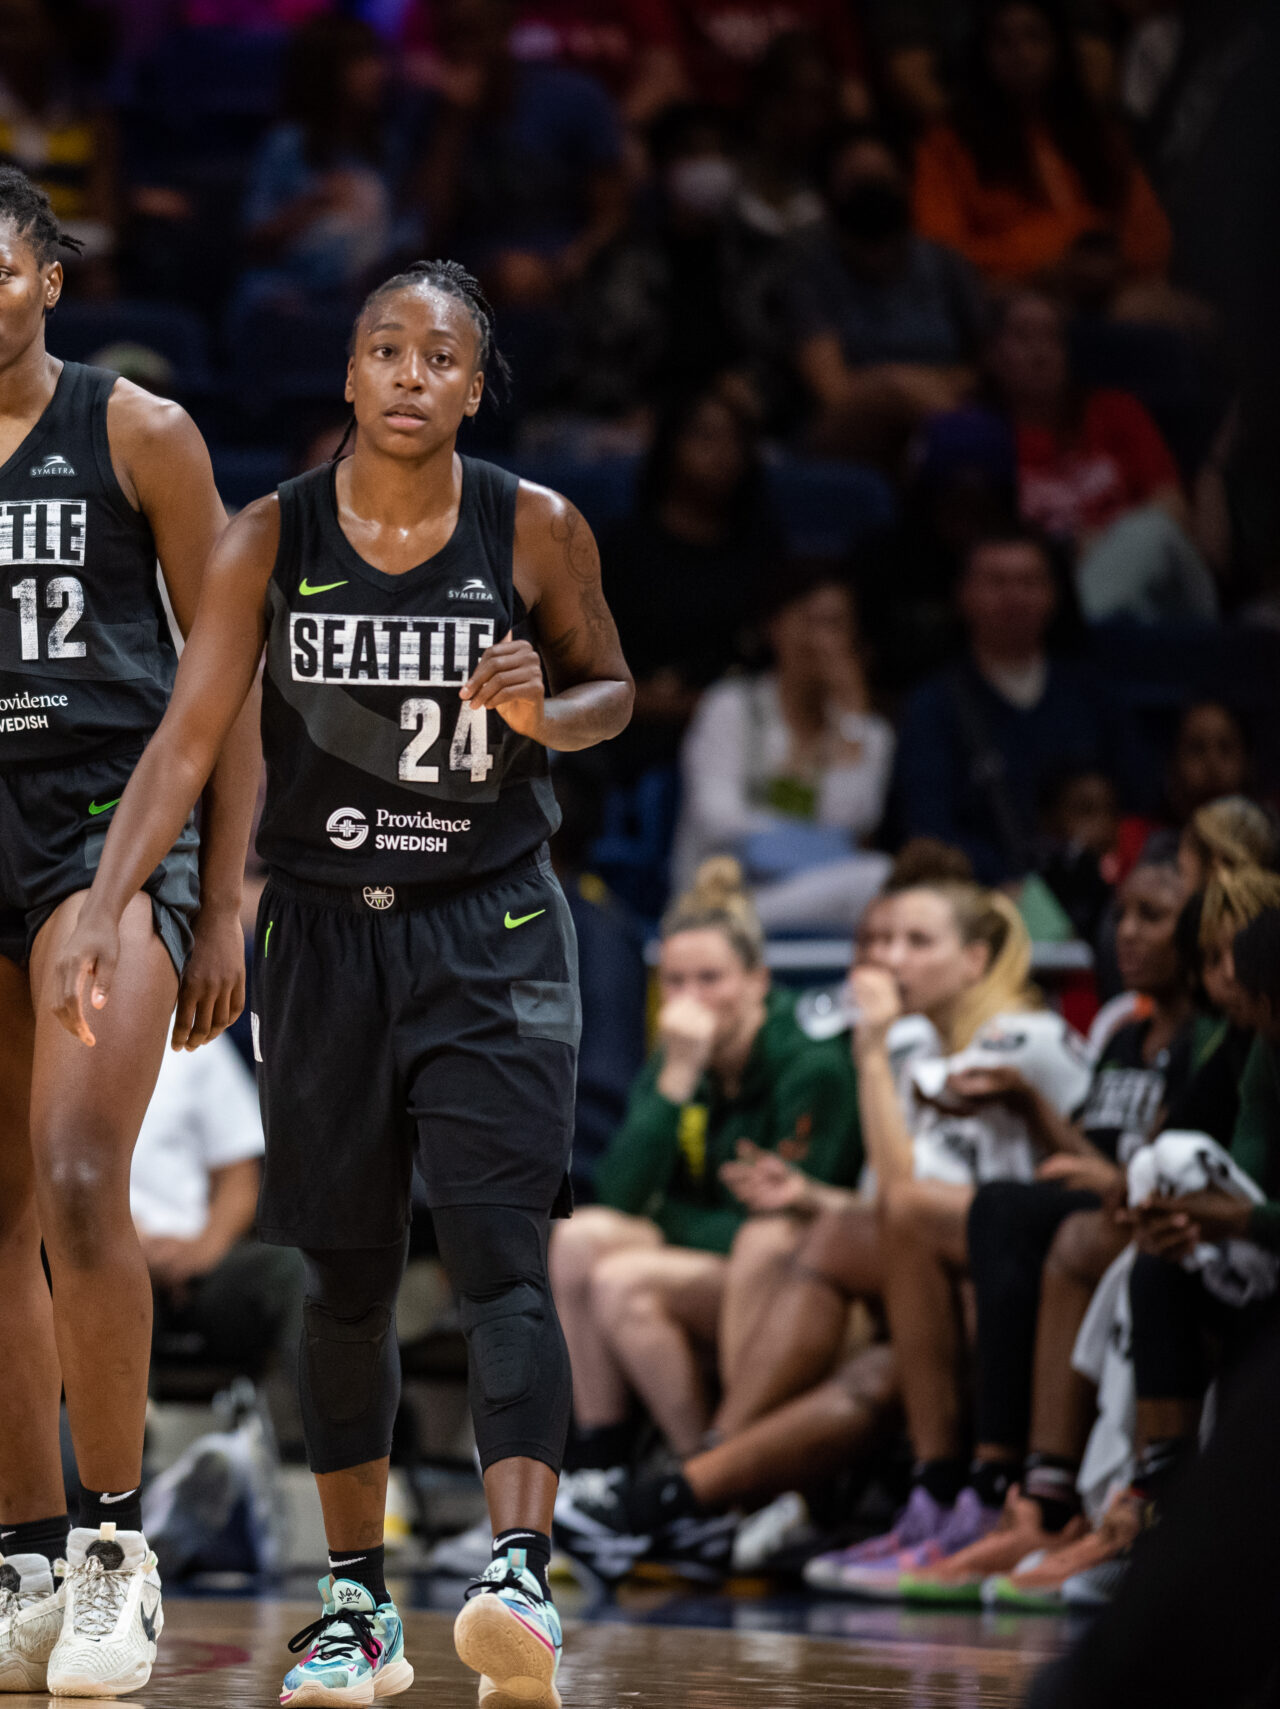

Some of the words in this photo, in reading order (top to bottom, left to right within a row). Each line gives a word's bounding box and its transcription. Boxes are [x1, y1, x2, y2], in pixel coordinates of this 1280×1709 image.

[31, 466, 75, 476] SYMETRA
[448, 589, 493, 601] SYMETRA
[11, 576, 87, 662] 12
[398, 698, 494, 783] 24
[376, 808, 472, 833] Providence
[375, 834, 448, 853] SWEDISH
